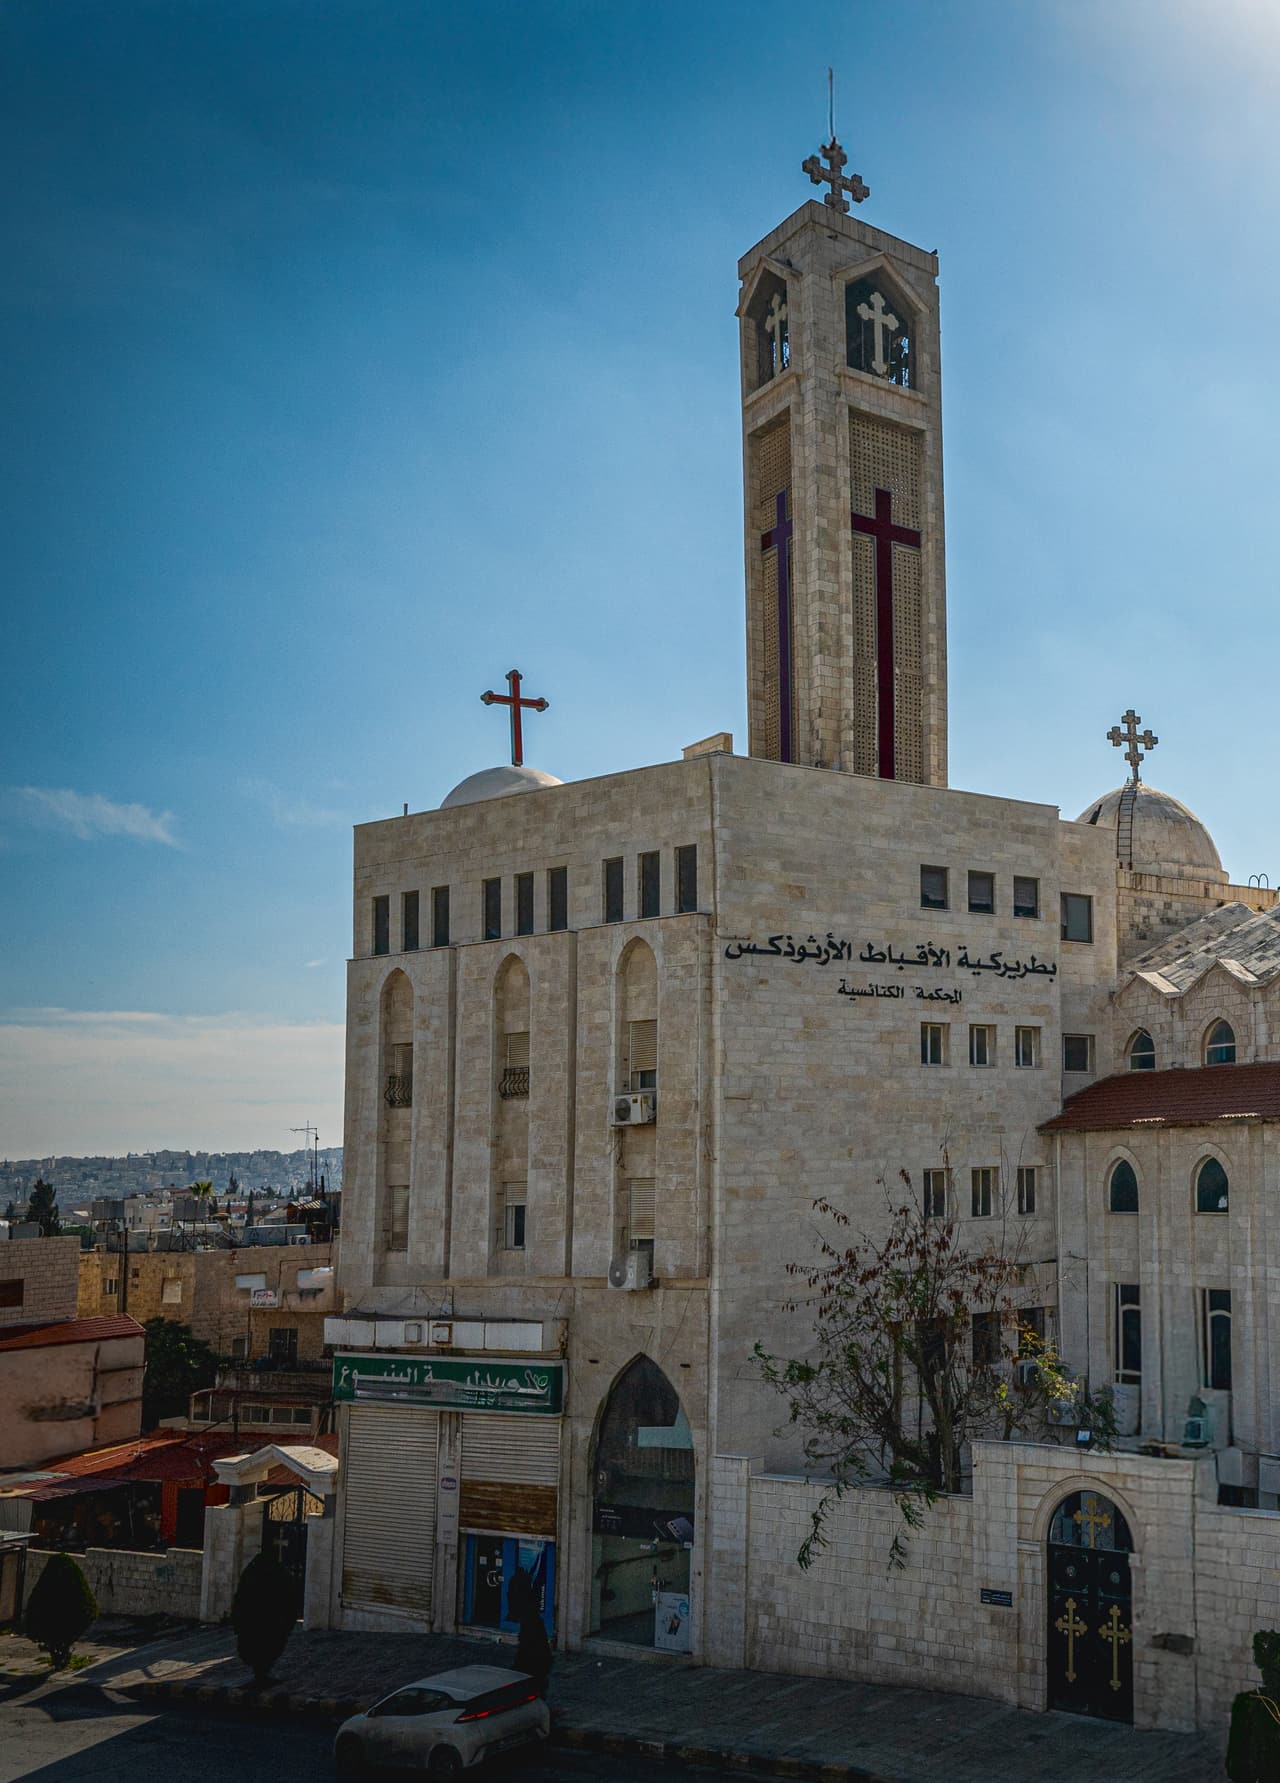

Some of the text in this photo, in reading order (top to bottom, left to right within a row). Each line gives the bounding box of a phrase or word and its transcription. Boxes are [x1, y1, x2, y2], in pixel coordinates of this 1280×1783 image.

[725, 932, 1058, 983] بطريركية الأقباط الأرثوذكس
[916, 986, 962, 1004] المحكمة
